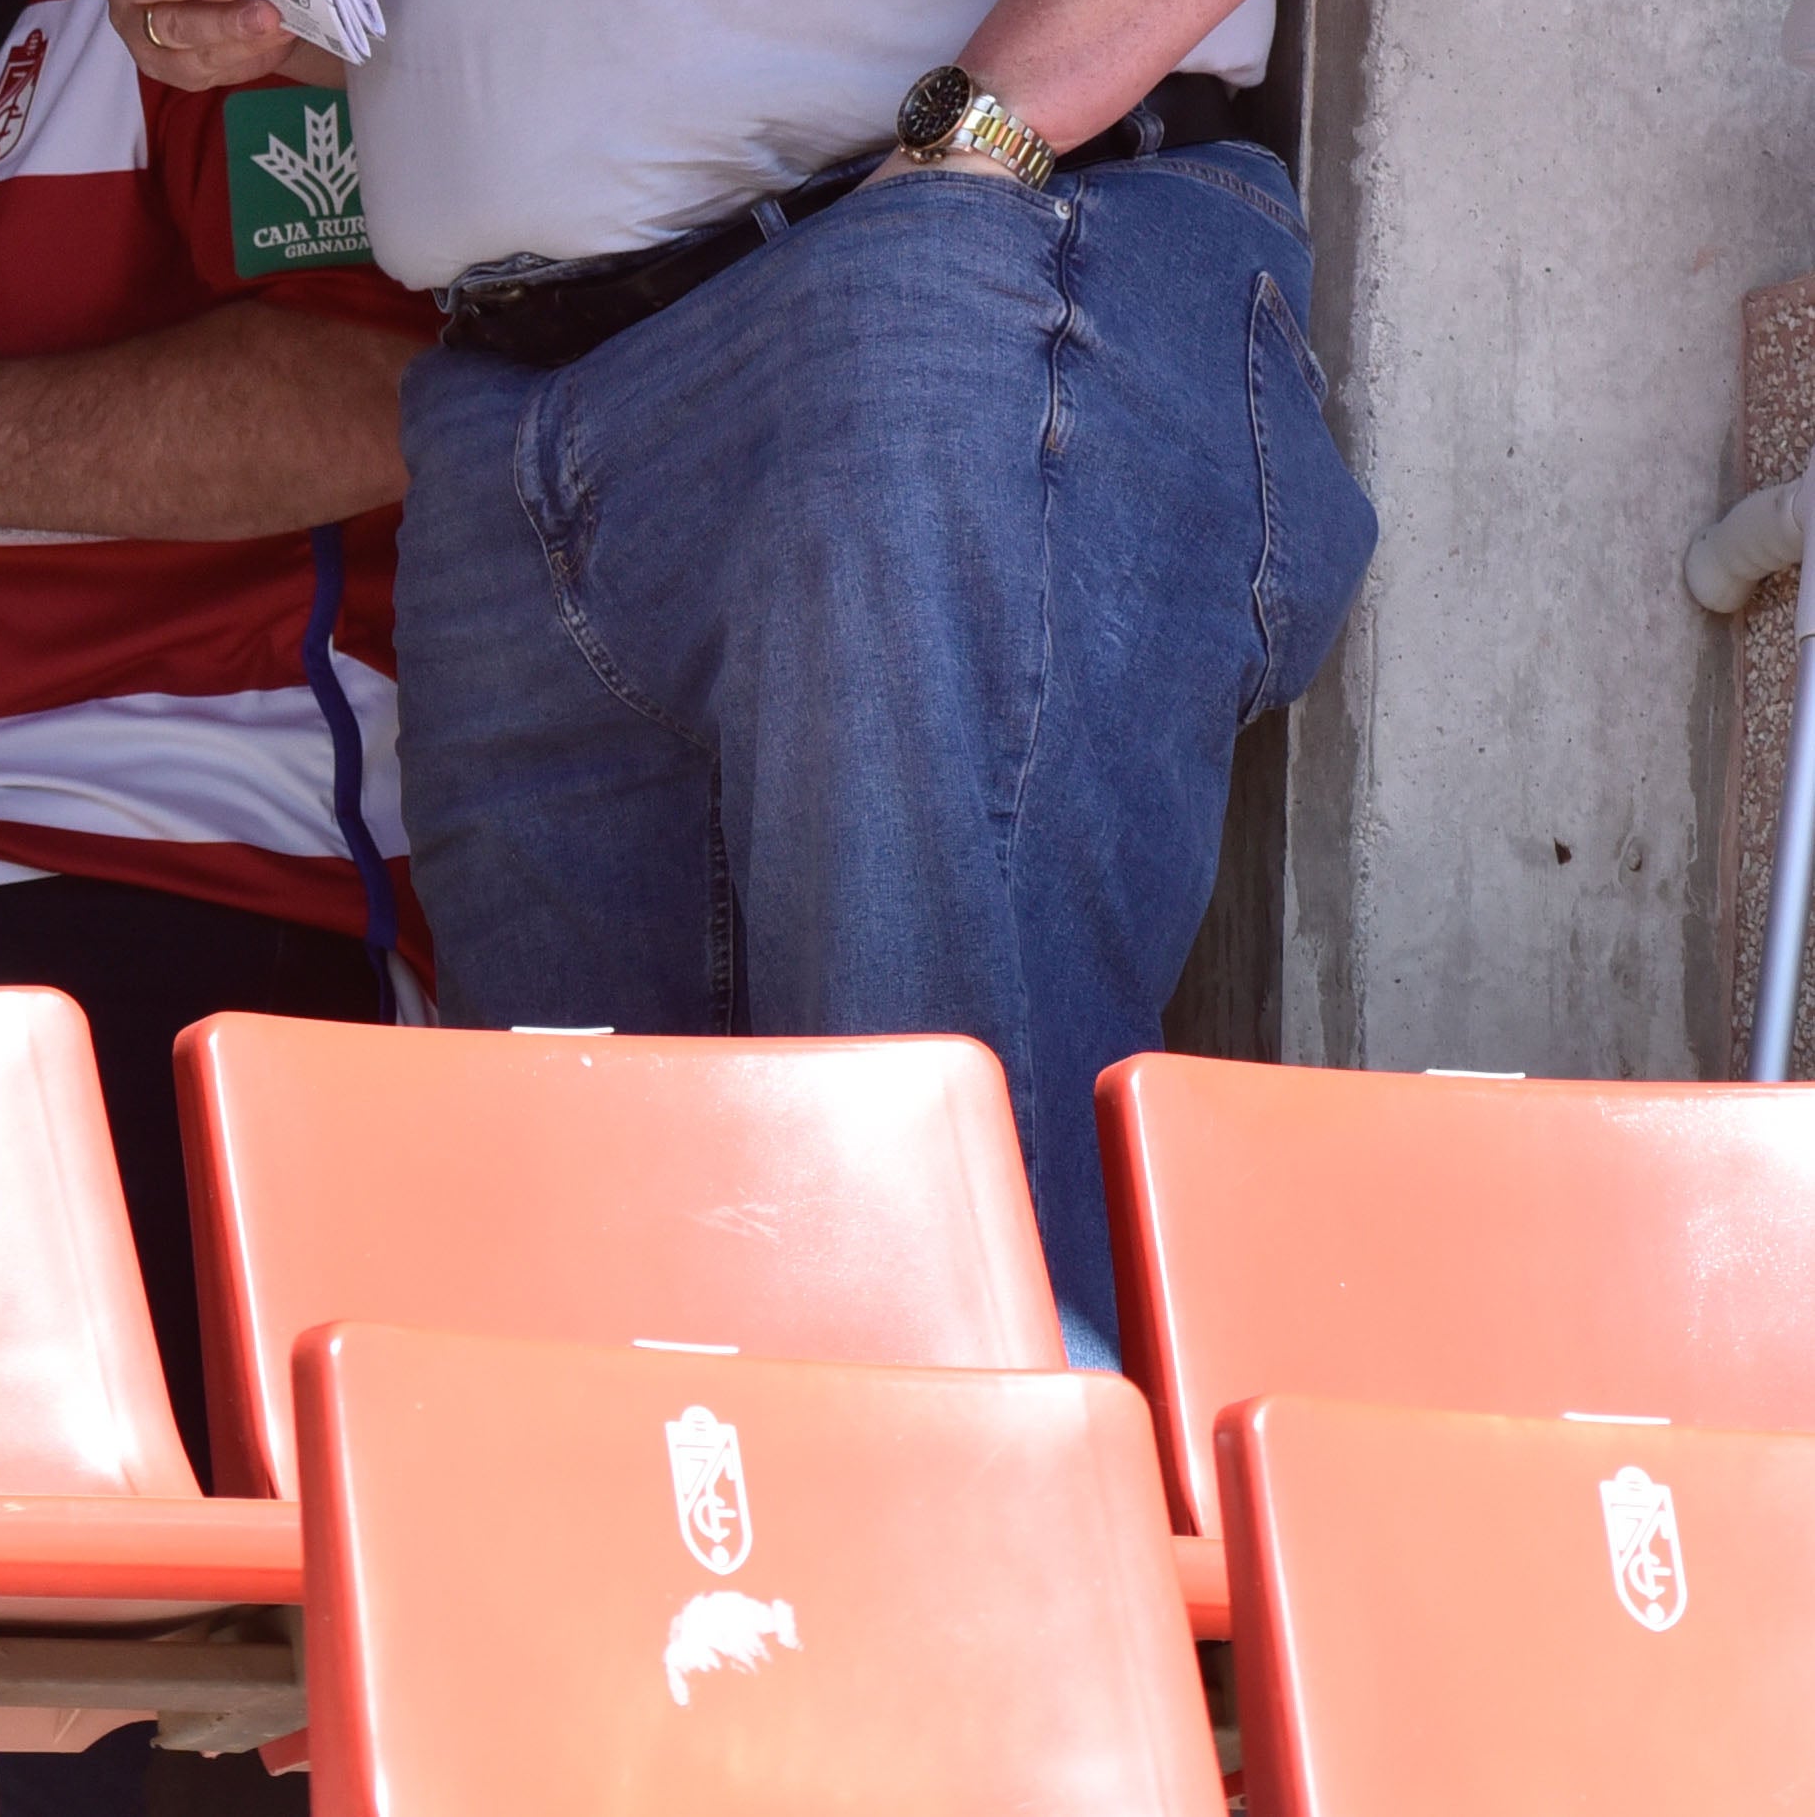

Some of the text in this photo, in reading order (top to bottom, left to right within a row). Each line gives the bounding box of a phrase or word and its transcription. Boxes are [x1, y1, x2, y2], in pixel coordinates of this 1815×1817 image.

[253, 215, 366, 248] CAJA RUR
[284, 236, 370, 259] GRANADA
